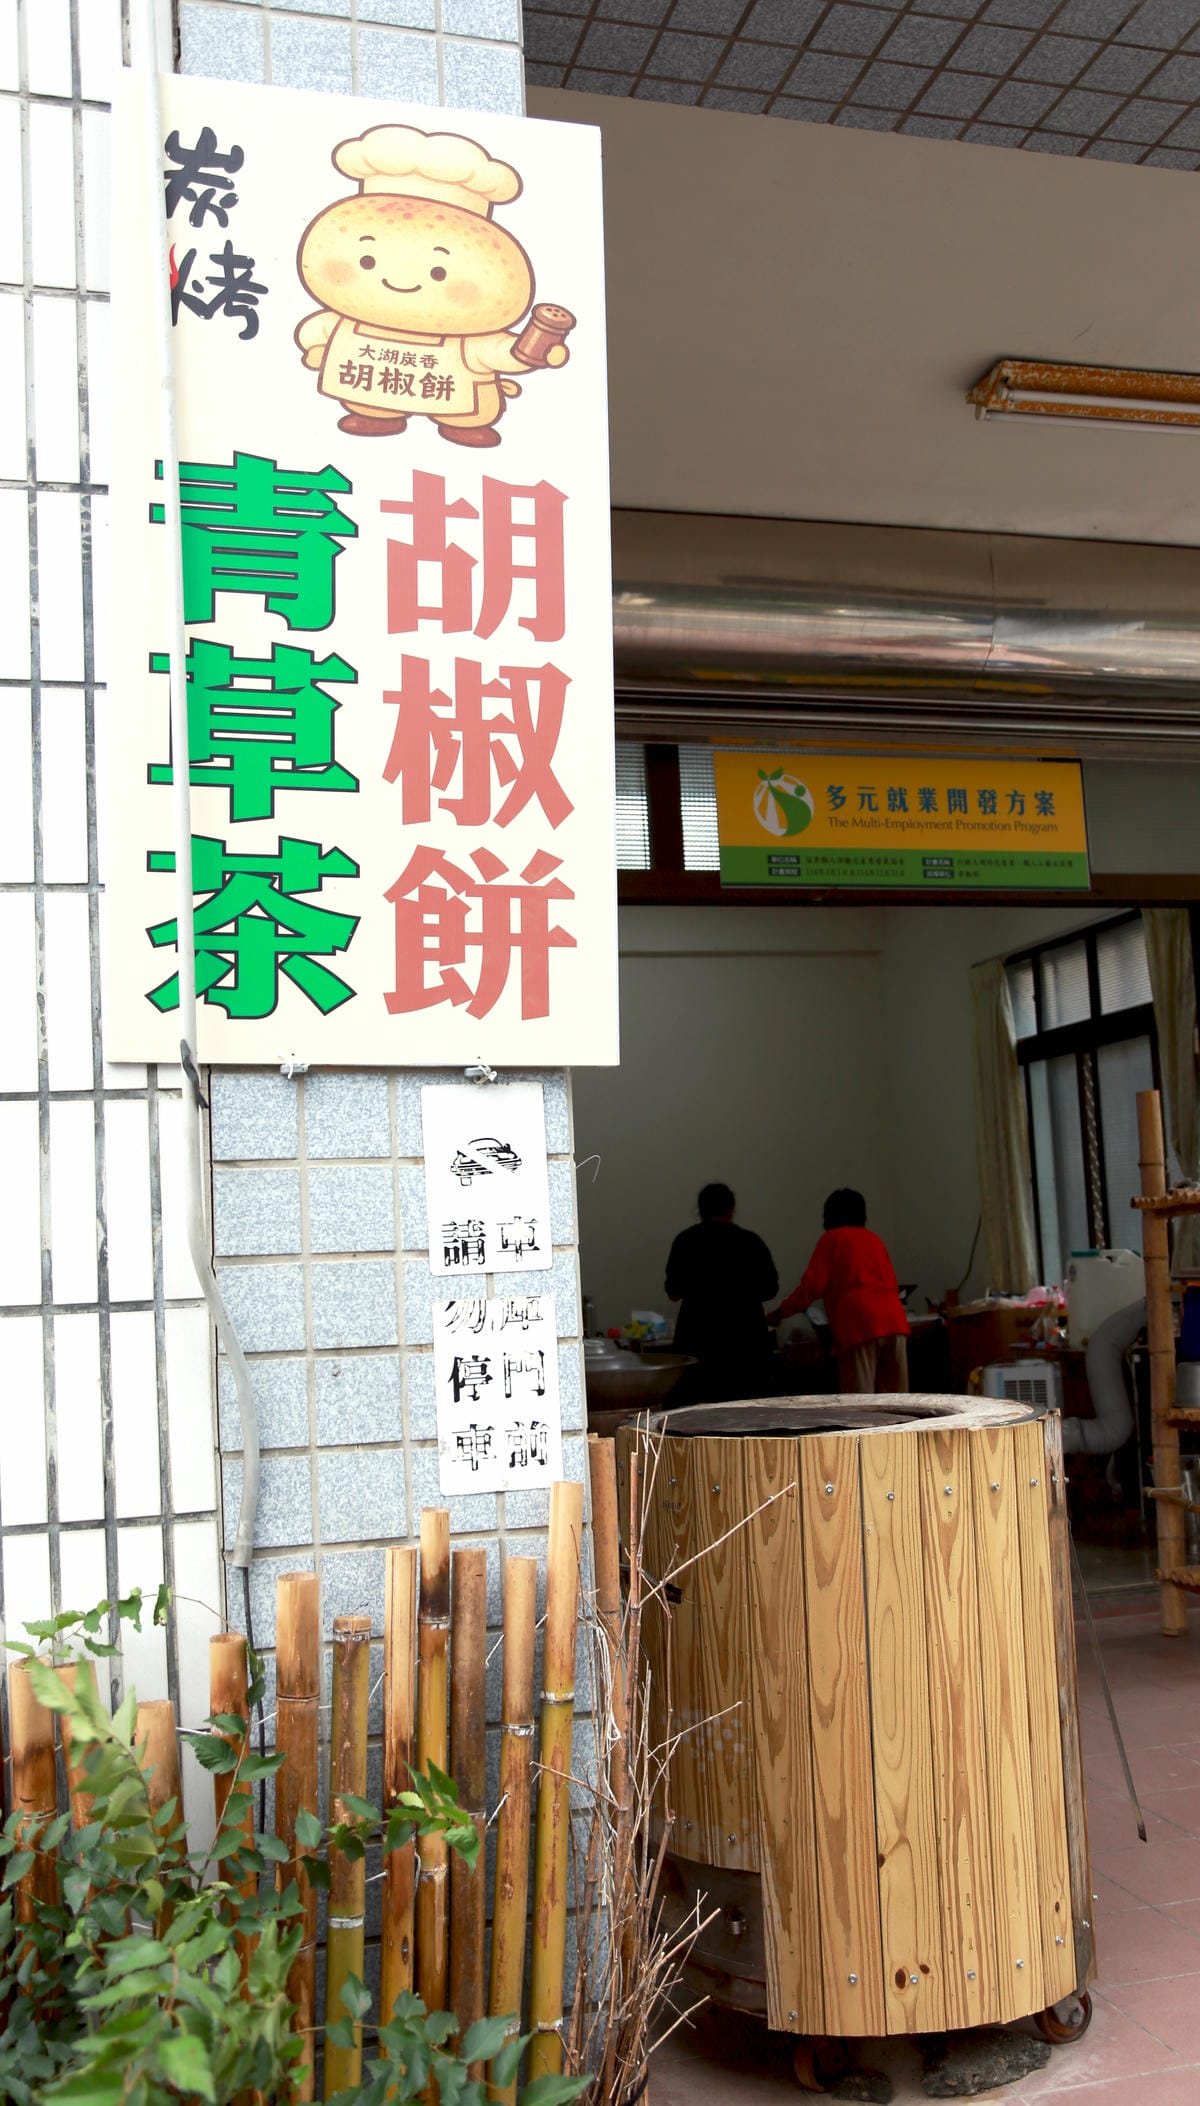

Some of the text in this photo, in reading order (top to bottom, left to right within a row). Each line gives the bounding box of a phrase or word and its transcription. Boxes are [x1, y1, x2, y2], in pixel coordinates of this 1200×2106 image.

[164, 126, 269, 341] 炭烤
[357, 343, 440, 369] 大湖炭香
[338, 360, 456, 402] 胡椒餅
[145, 450, 361, 1020] 青草茶
[380, 469, 577, 1021] 胡椒餅
[826, 784, 1056, 817] 多元就業開發方案
[828, 816, 1058, 835] The Multi-Employment Promotion Program
